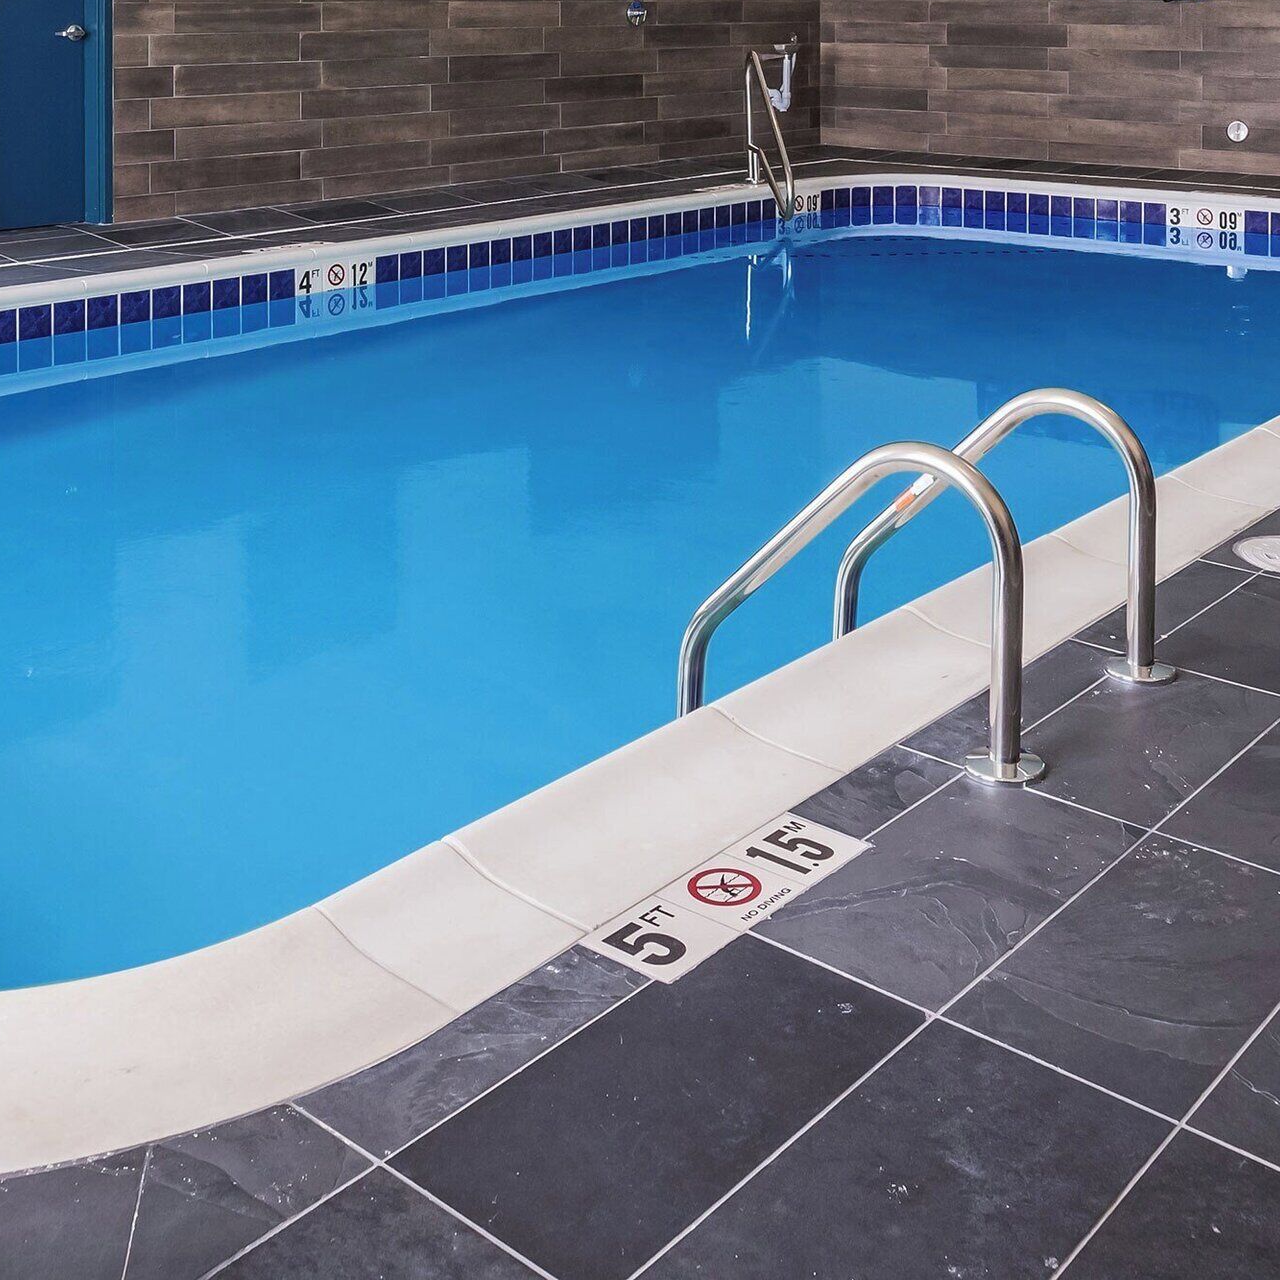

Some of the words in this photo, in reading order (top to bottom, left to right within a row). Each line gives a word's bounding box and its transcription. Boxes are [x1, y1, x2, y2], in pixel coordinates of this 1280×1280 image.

[1169, 207, 1181, 225] 3
[299, 271, 312, 294] 4
[312, 269, 320, 278] FT
[783, 820, 807, 834] M
[746, 829, 835, 875] 1.5
[639, 904, 676, 928] FT
[741, 909, 759, 922] NO
[758, 887, 792, 912] DIVING
[602, 922, 687, 966] 5
